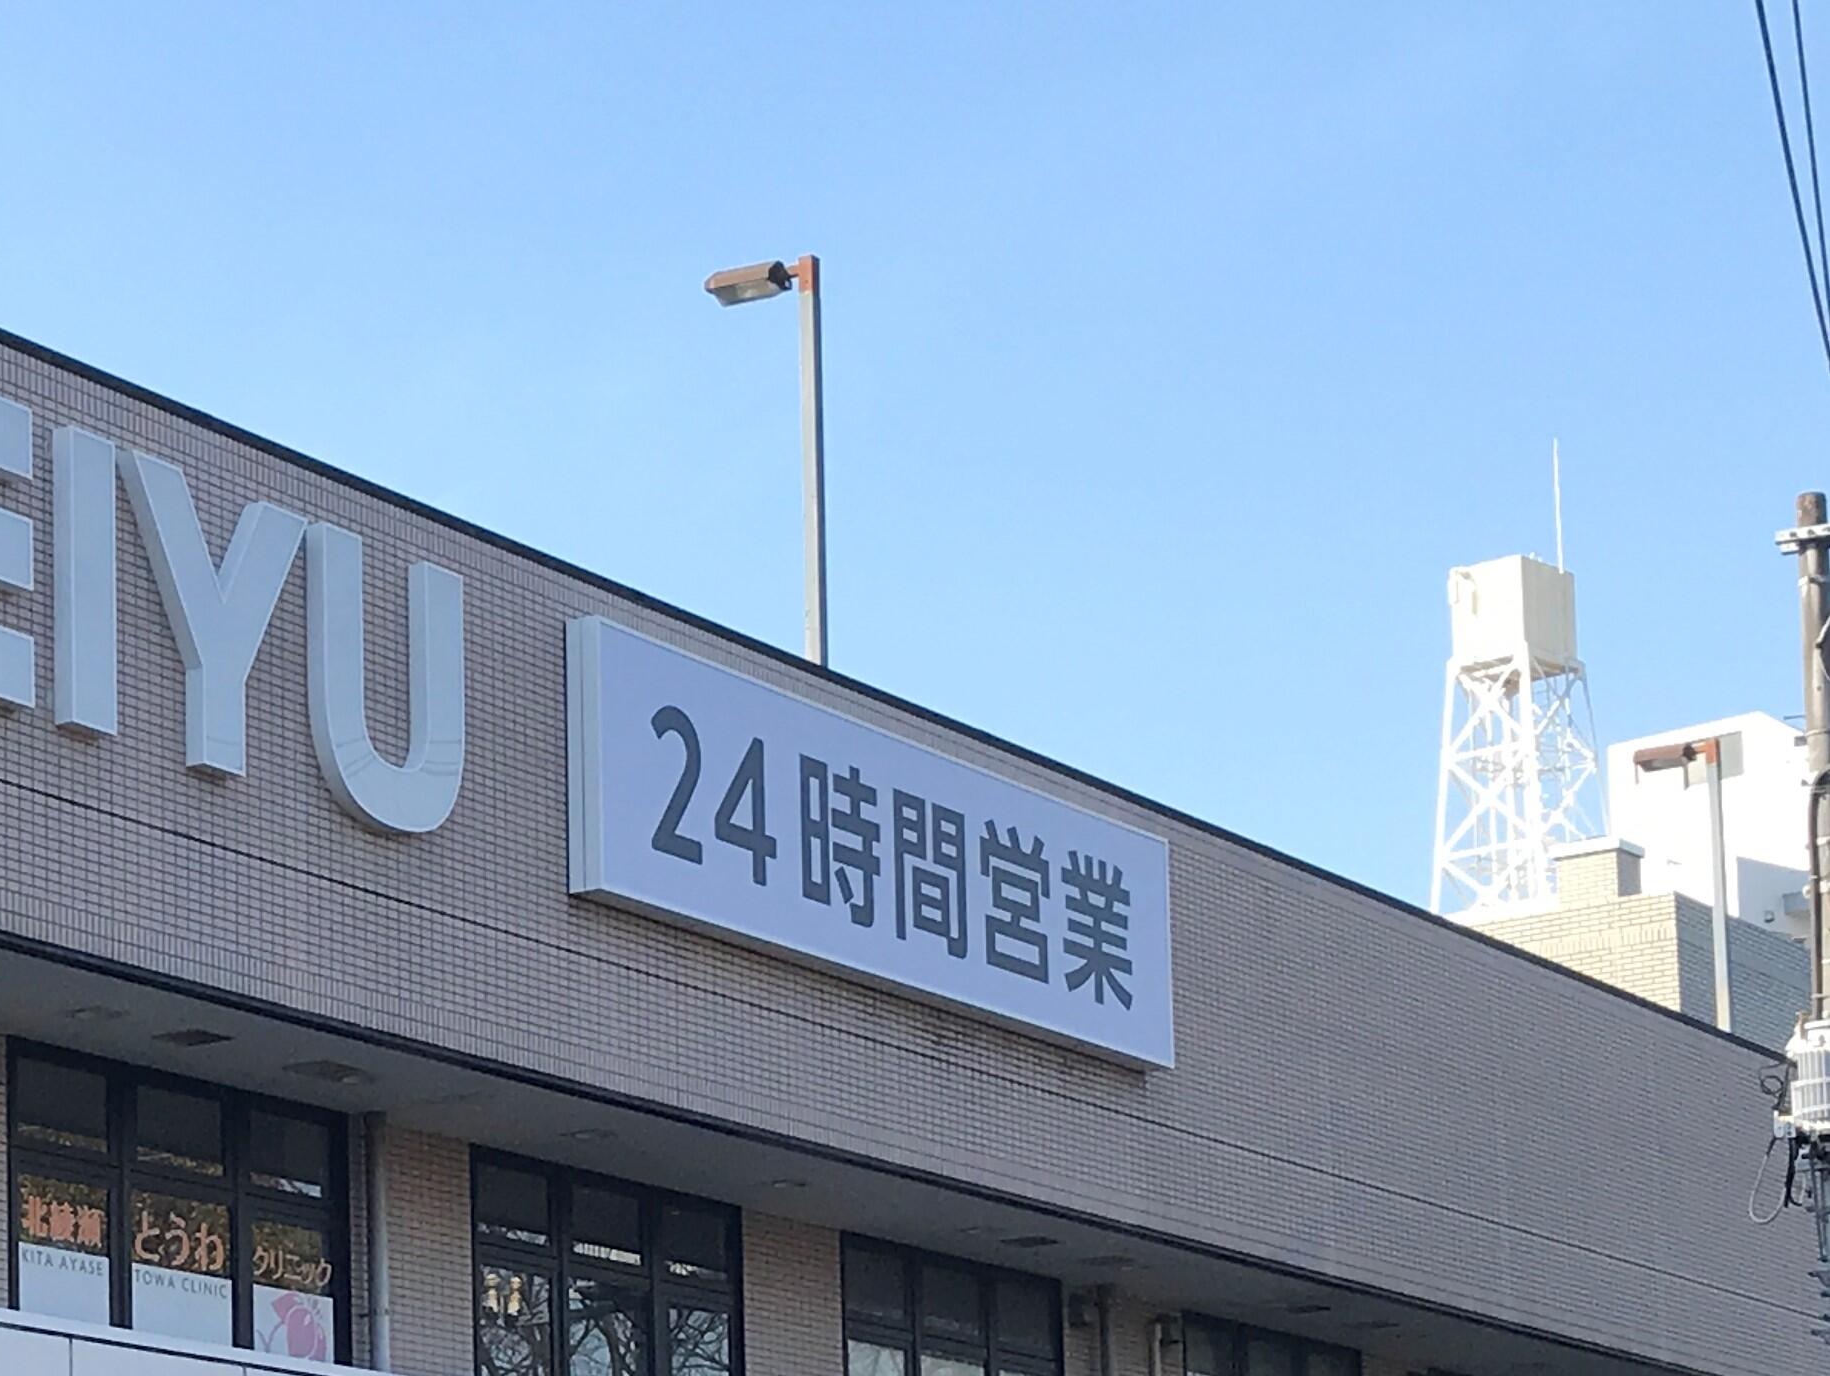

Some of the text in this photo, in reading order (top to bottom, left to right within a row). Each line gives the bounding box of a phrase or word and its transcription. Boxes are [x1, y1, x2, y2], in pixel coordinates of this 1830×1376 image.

[650, 705, 1133, 1011] 24時間営業
[21, 1248, 227, 1299] KITA AYASE TOWA CLINIC
[134, 1210, 225, 1271] とうわ
[252, 1245, 332, 1287] クリニック
